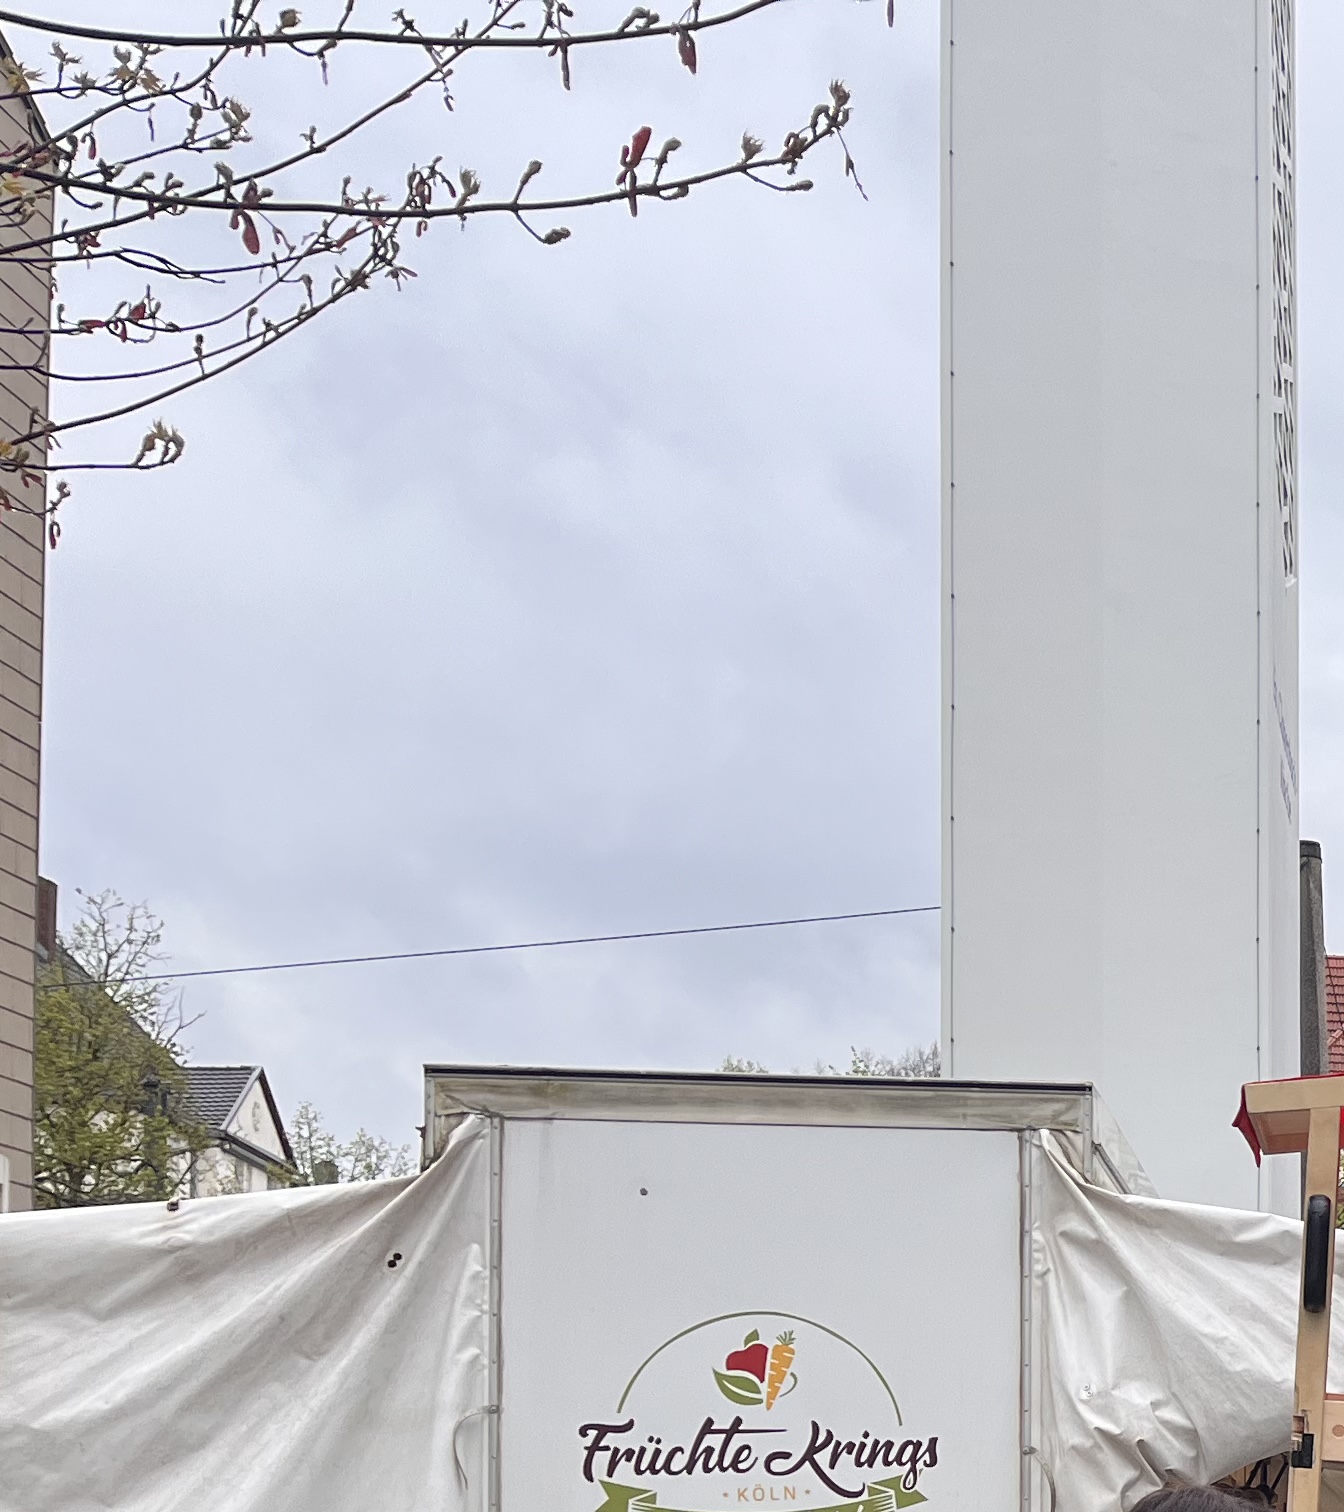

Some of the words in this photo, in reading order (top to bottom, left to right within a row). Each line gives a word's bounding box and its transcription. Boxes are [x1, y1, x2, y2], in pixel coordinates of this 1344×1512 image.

[578, 1415, 788, 1483] Früchte
[763, 1419, 939, 1499] Krings
[736, 1483, 797, 1503] KÖLN
